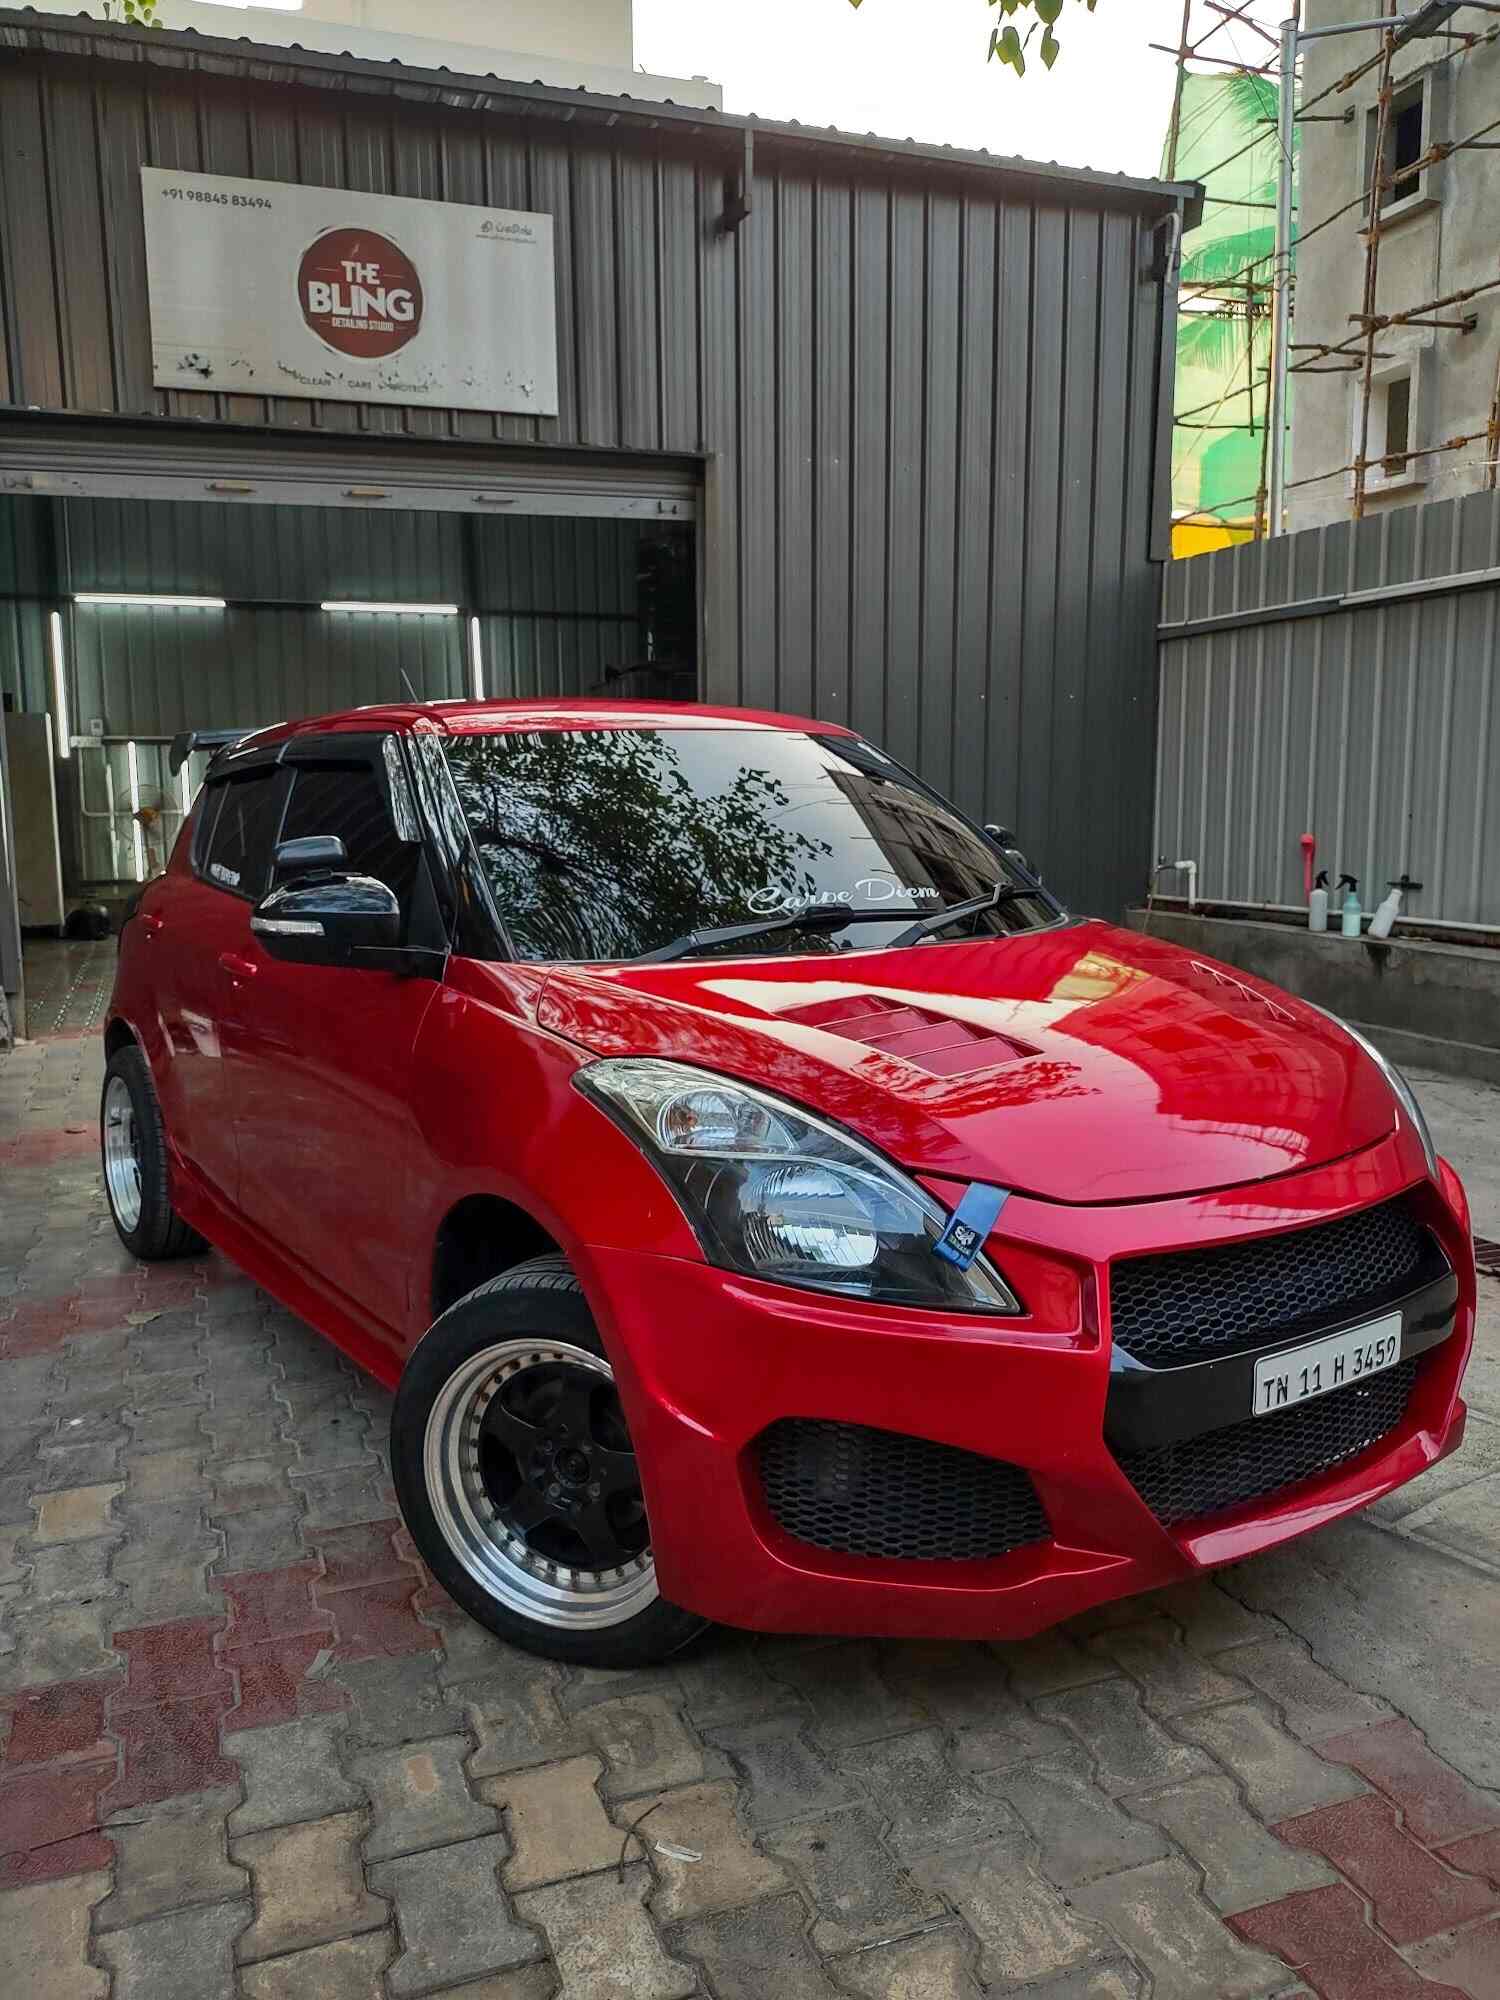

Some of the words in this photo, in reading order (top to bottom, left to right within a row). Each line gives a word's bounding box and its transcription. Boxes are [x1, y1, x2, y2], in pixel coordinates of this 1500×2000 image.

[161, 188, 183, 200] +91
[186, 190, 229, 205] 98845
[231, 195, 272, 209] 83494
[340, 260, 380, 285] THE
[308, 280, 415, 321] BLING
[855, 878, 940, 901] Diem
[1263, 1374, 1289, 1408] TN
[1299, 1362, 1322, 1396] 11
[1333, 1351, 1345, 1383] H
[1353, 1334, 1396, 1376] 3459
